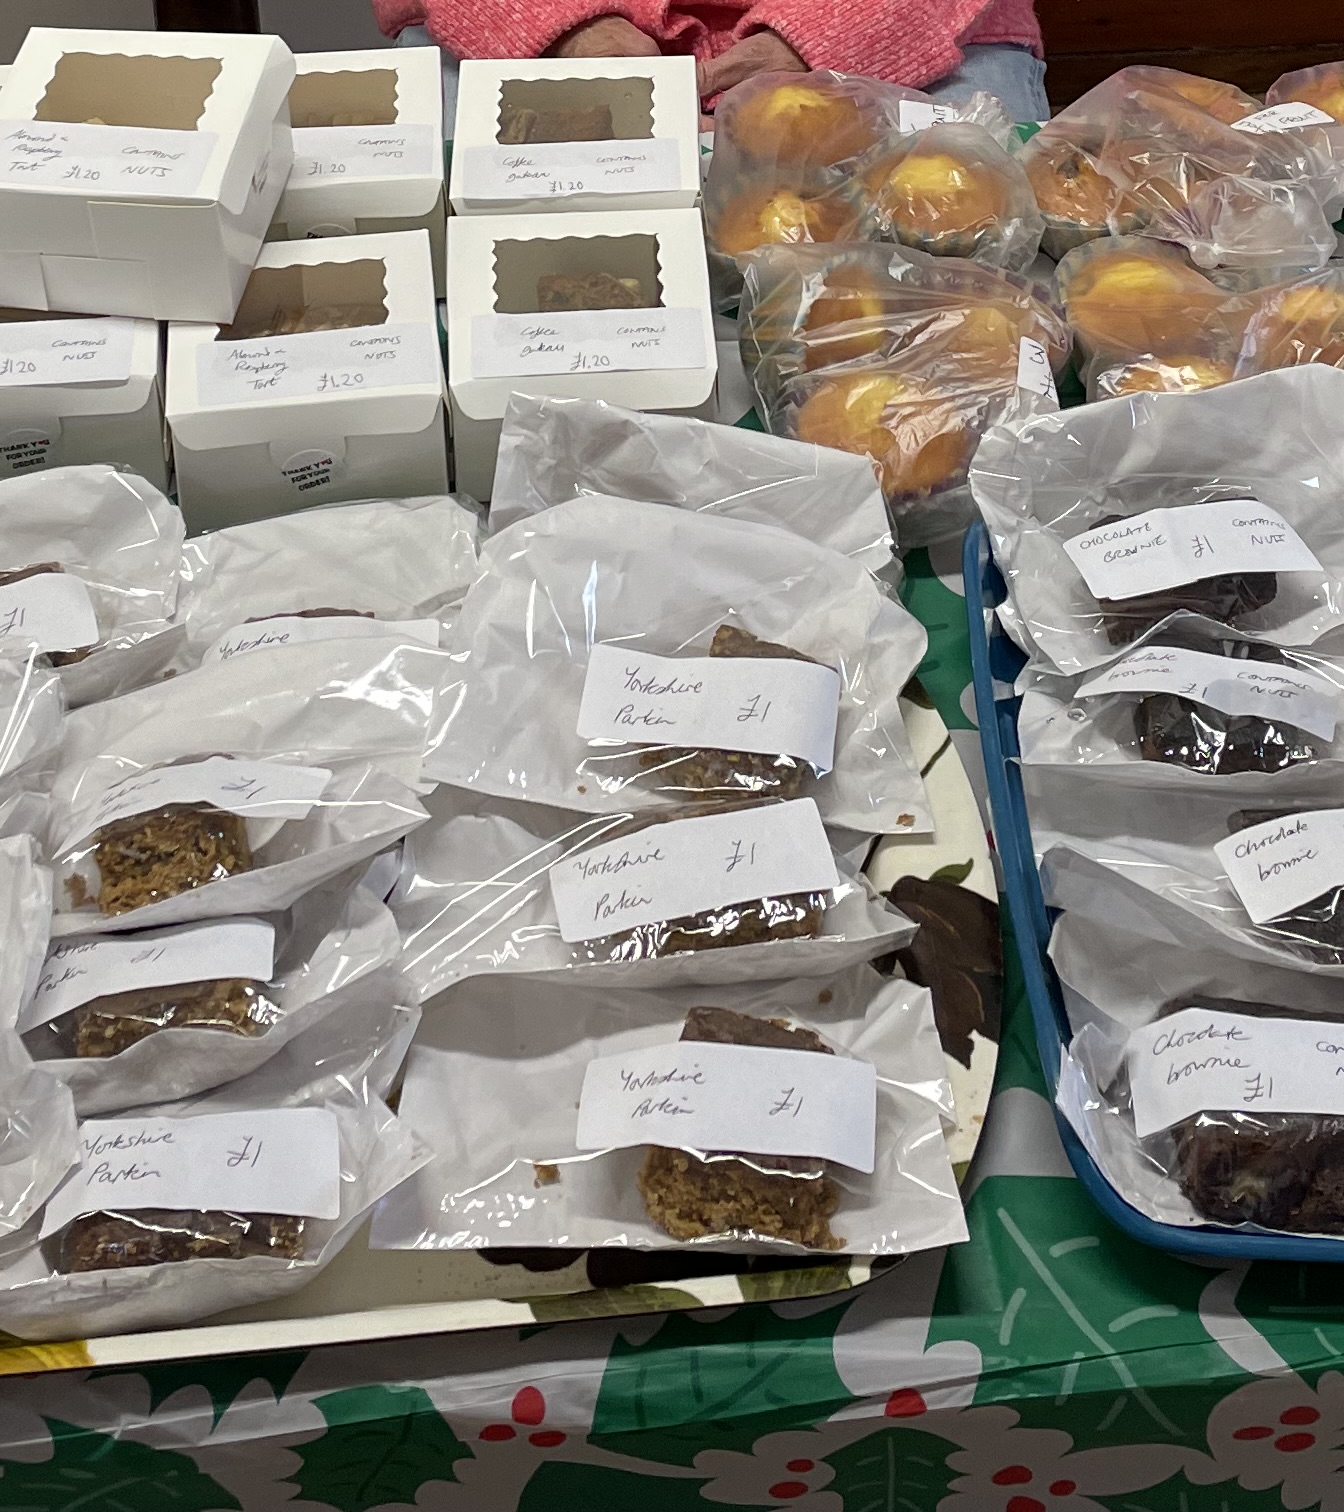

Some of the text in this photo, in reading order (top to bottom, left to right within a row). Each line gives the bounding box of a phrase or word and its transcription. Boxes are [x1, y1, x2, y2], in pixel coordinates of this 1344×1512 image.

[1078, 520, 1153, 551] CHOCOLATE
[1102, 533, 1287, 564] BROWNIE £1 NUTS
[624, 665, 772, 724] Yorkshire £1
[612, 703, 678, 726] Parkin
[1233, 820, 1310, 860] Chocolate
[573, 839, 758, 881] Yorkshire £1
[592, 886, 654, 922] Parkin
[1151, 1023, 1253, 1056] Chocolate
[1164, 1051, 1253, 1086] brownie
[768, 1087, 804, 1117] £1
[1244, 1072, 1274, 1102] £1
[80, 1129, 261, 1169] Yorkshire £1
[86, 1162, 162, 1188] Parkin
